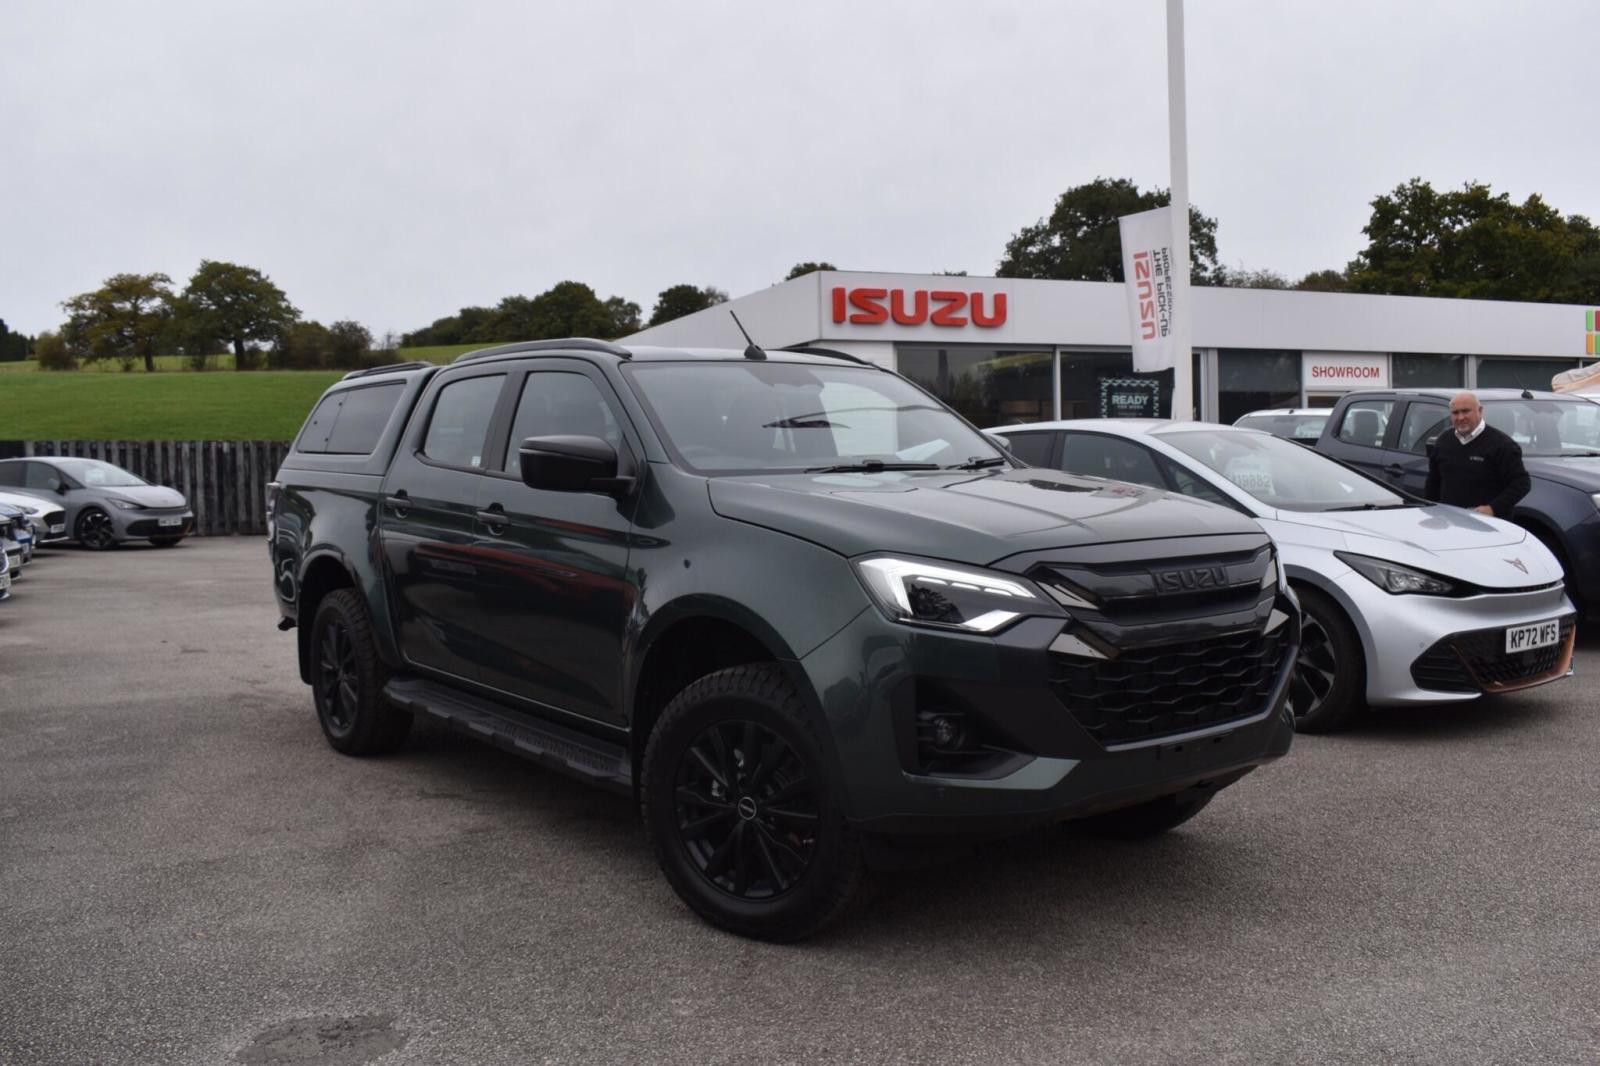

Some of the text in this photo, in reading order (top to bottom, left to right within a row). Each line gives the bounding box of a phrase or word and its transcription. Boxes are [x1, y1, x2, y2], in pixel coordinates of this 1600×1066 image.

[832, 287, 1007, 328] ISUZU
[1312, 366, 1380, 378] SHOWROOM
[1112, 395, 1149, 405] READY
[1154, 567, 1226, 593] ISUZU
[1511, 623, 1556, 649] KP72 WFS
